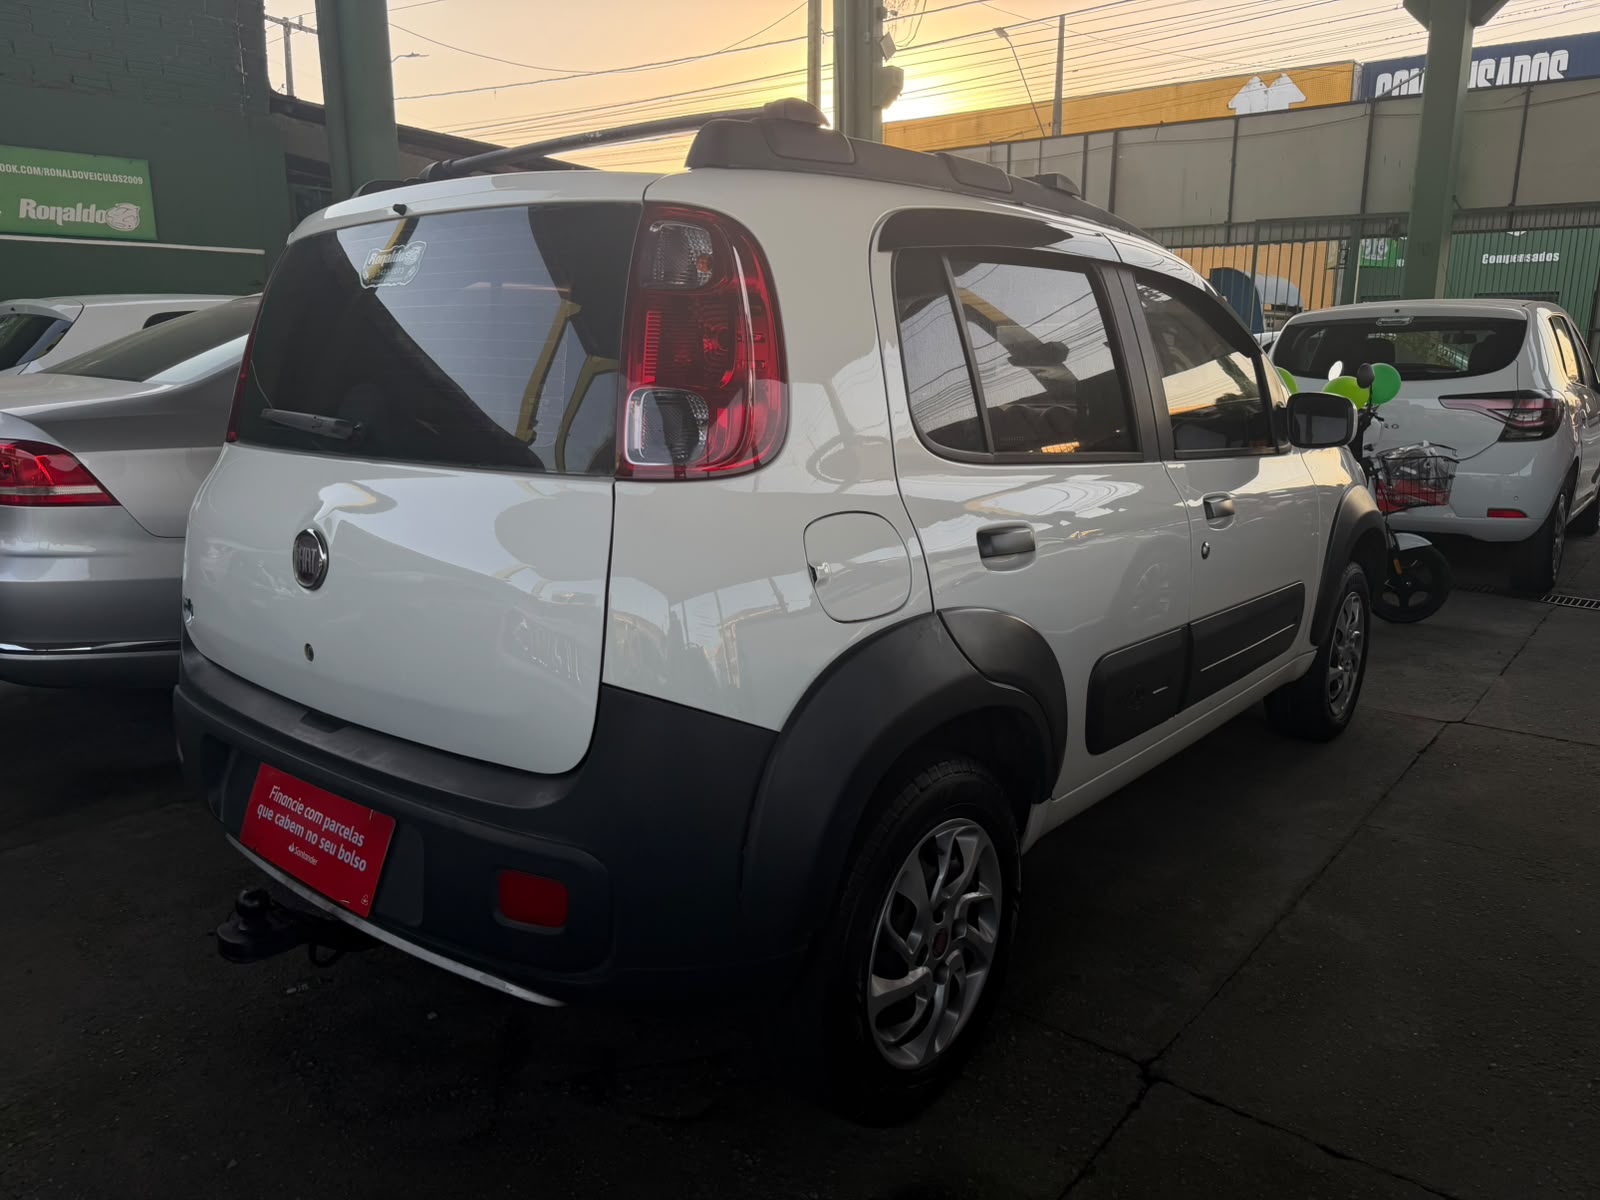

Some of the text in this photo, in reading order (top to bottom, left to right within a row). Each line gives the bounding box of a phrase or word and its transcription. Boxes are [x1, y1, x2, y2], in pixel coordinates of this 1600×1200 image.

[19, 198, 107, 226] Ronaldo
[1482, 251, 1560, 264] Compensados
[299, 546, 318, 574] FIAT
[268, 785, 365, 847] Financie com parcelas
[257, 804, 367, 872] que cabem no seu bolso
[294, 846, 319, 866] Santander
